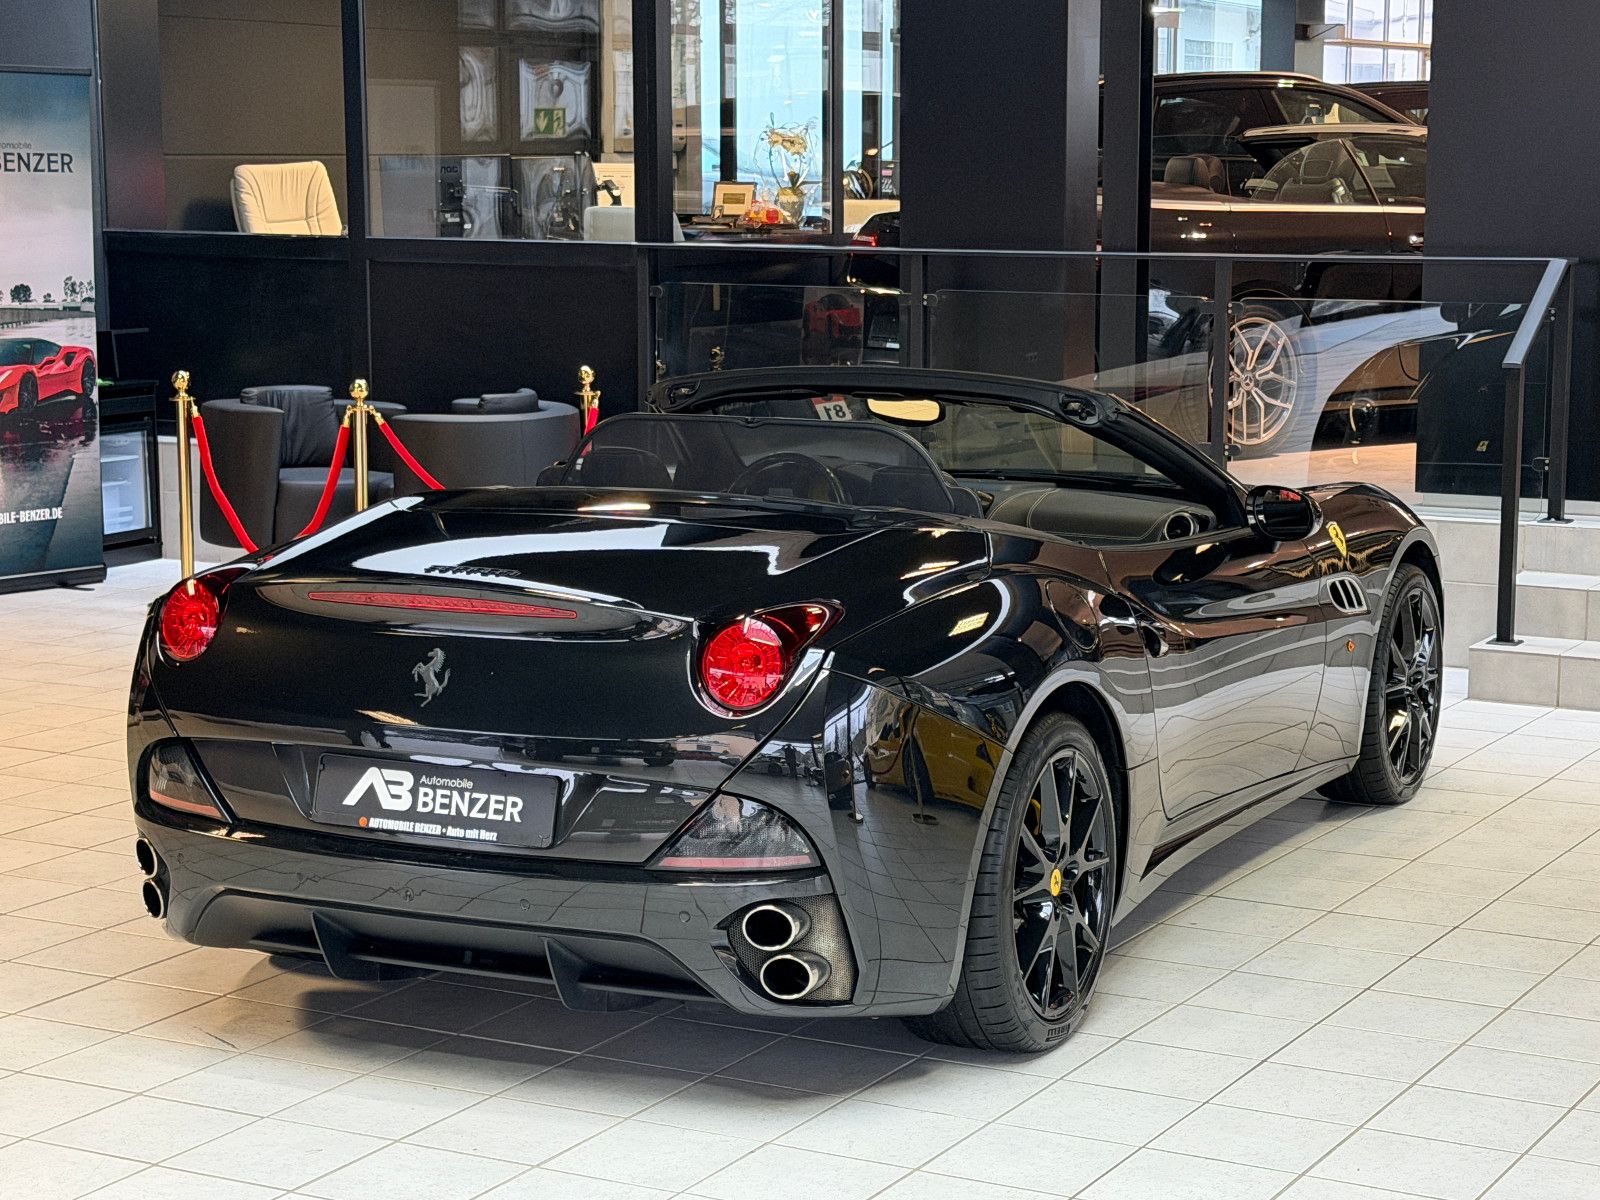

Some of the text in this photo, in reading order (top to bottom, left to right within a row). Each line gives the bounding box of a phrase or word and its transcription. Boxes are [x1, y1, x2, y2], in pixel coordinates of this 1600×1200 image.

[0, 152, 74, 173] ENZER
[420, 774, 474, 790] Automobile
[416, 786, 524, 824] BENZER
[368, 817, 498, 842] AUTOMOBILE BENZER Auto mit Herz
